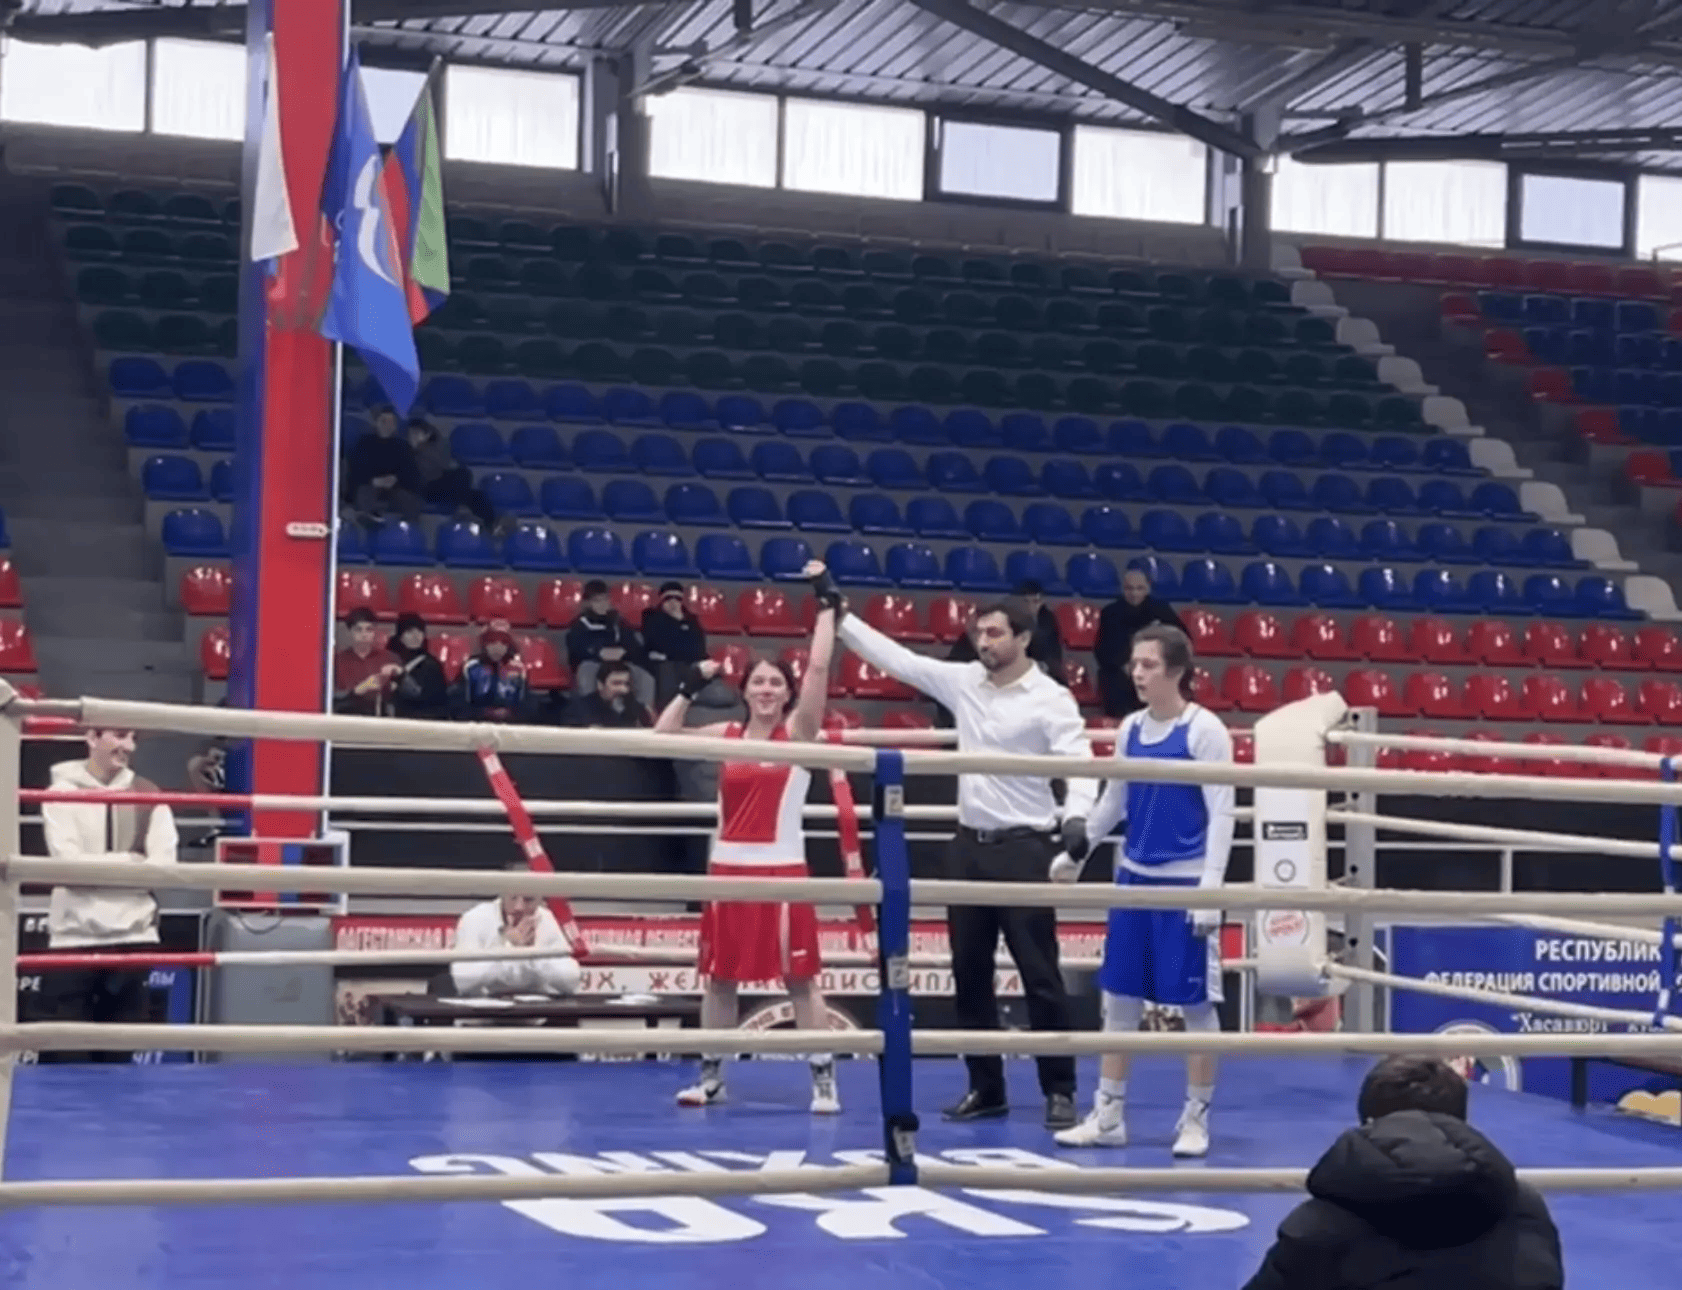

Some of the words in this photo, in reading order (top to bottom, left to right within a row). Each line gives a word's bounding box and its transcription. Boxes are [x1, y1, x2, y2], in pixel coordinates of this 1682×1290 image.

[1535, 940, 1662, 962] РЕСПУБЛИК
[579, 971, 628, 991] УХ,
[1424, 971, 1535, 993] ФЕДЕРАЦИЯ
[1538, 970, 1662, 993] СПОРТИВНОЙ
